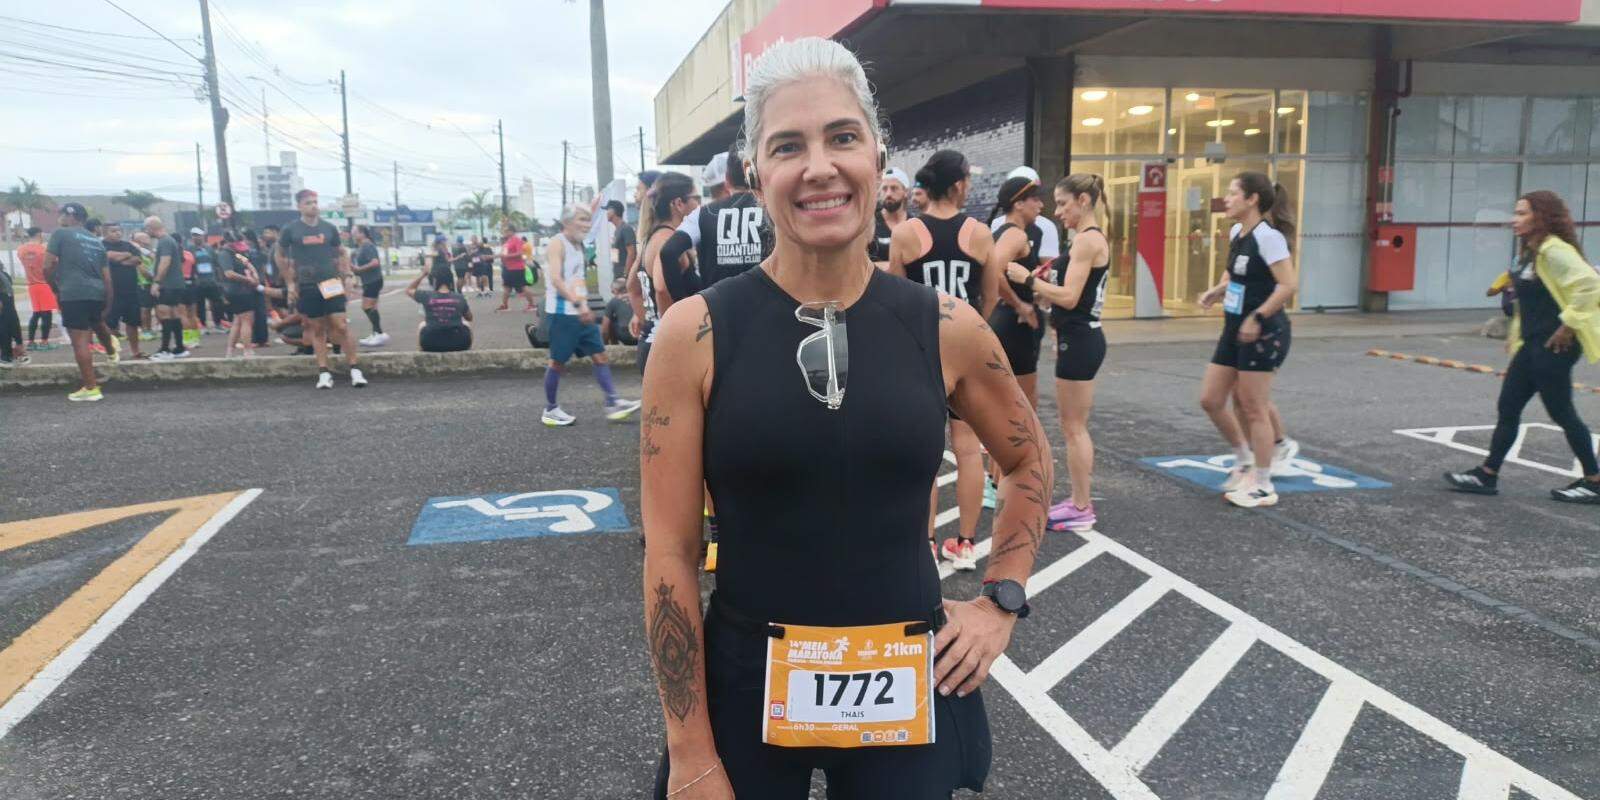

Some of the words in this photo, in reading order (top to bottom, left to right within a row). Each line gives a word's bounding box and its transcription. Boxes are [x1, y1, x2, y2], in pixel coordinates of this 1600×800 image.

[717, 207, 763, 244] QR
[717, 243, 761, 257] QUANTUM
[717, 256, 744, 265] RUNNING
[923, 260, 970, 298] QR
[802, 640, 828, 651] MEIA
[883, 642, 922, 657] 21km
[788, 649, 843, 661] MARATONA
[815, 671, 894, 706] 1772
[832, 723, 859, 731] GERAL
